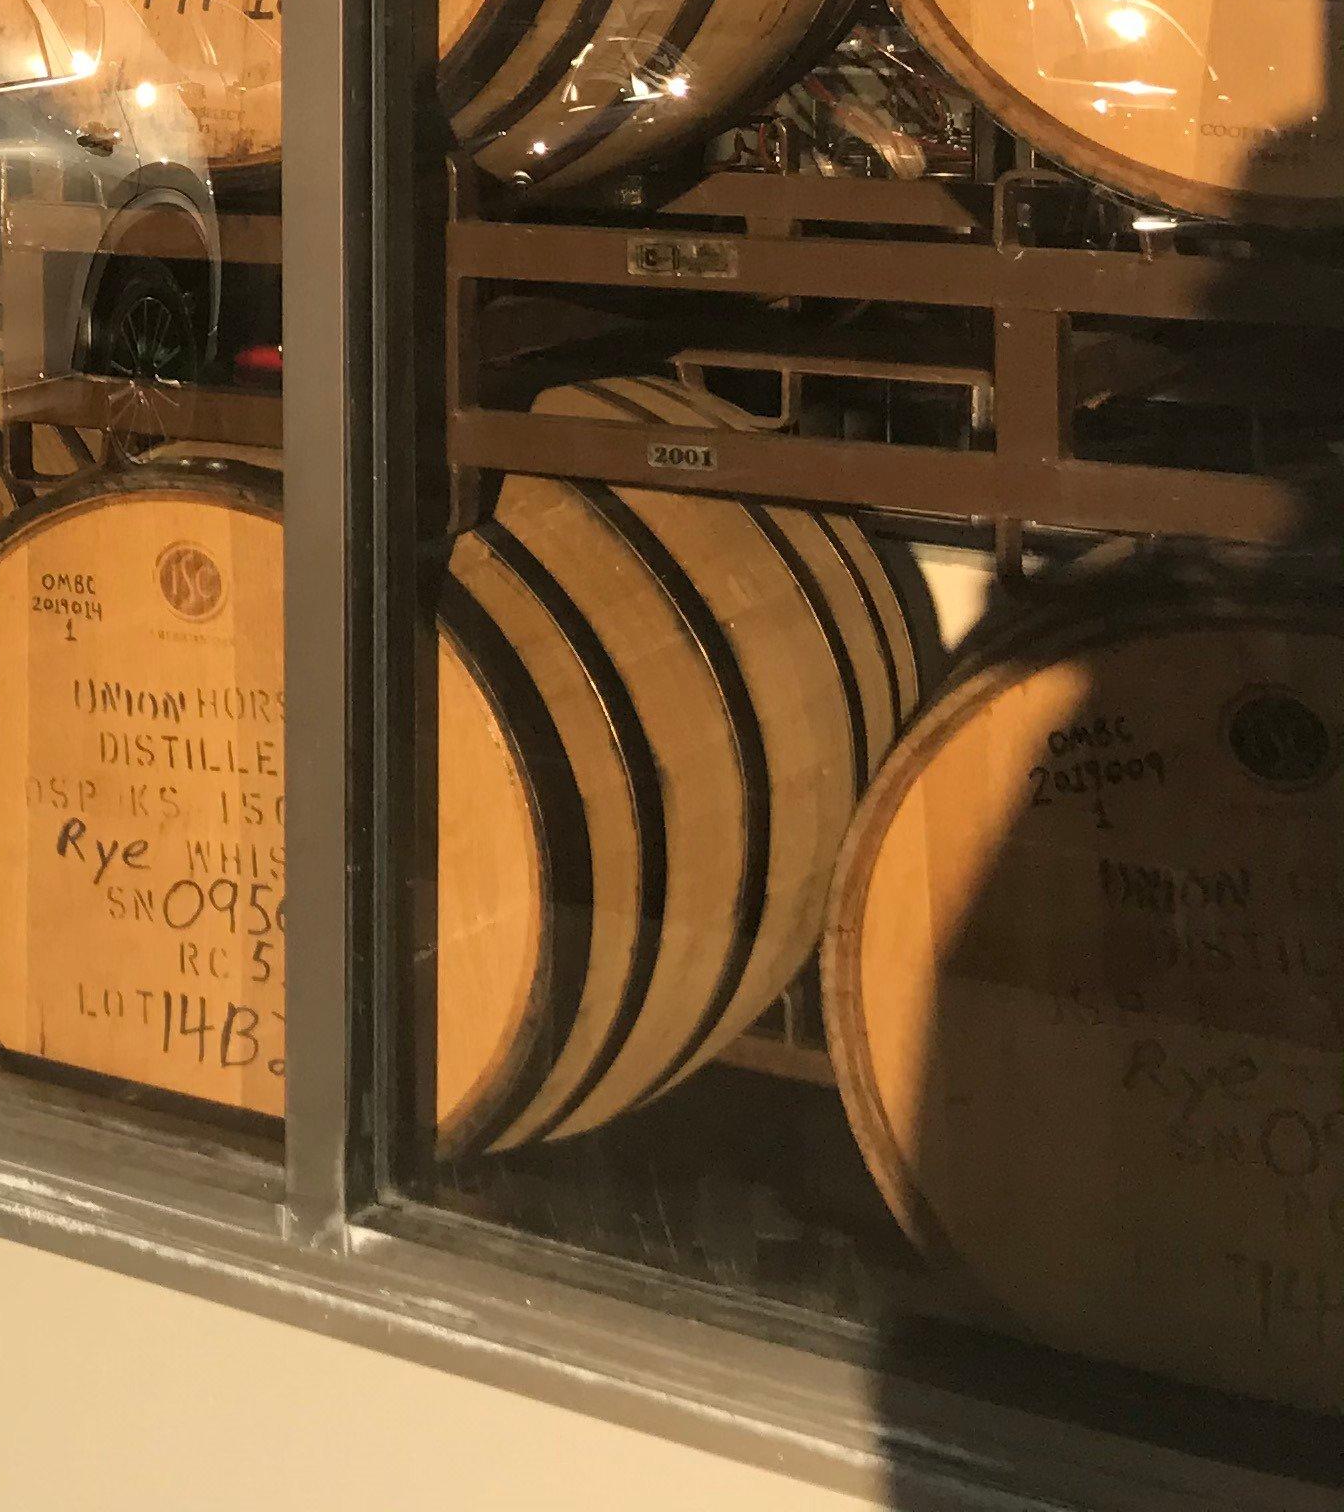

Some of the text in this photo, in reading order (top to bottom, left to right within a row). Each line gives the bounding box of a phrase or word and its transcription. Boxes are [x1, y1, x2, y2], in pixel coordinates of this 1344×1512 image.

[654, 447, 713, 466] 2001
[41, 574, 96, 595] OMBC
[32, 597, 102, 621] 2019014
[64, 619, 77, 641] 1
[73, 679, 186, 724] UNION
[129, 784, 180, 818] KS
[56, 817, 151, 885] Rye
[107, 887, 154, 922] SN
[180, 942, 230, 978] RC
[78, 983, 154, 1025] LOT
